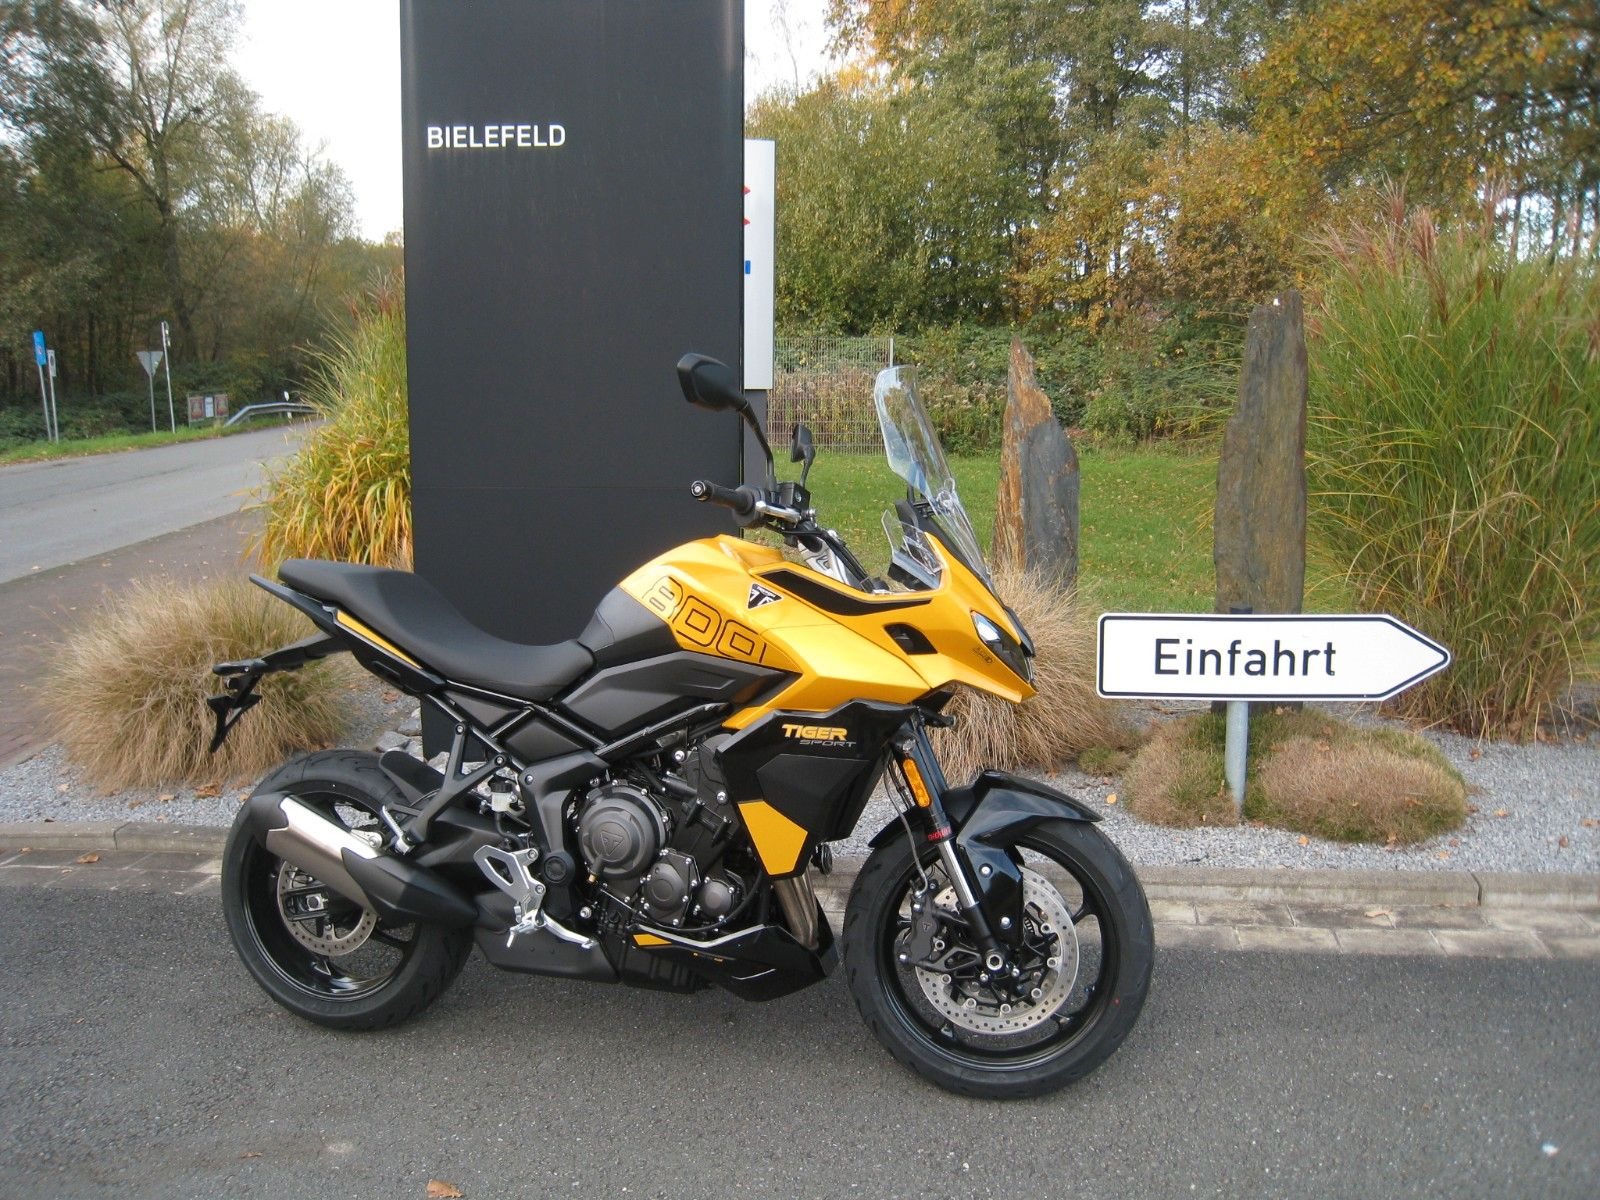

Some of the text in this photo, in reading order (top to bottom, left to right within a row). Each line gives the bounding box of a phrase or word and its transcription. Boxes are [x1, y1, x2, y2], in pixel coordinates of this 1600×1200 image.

[427, 124, 566, 149] BIELEFELD
[642, 575, 767, 664] 800
[1154, 638, 1336, 676] Einfahrt
[781, 723, 848, 741] TIGER
[799, 739, 857, 748] SPORT
